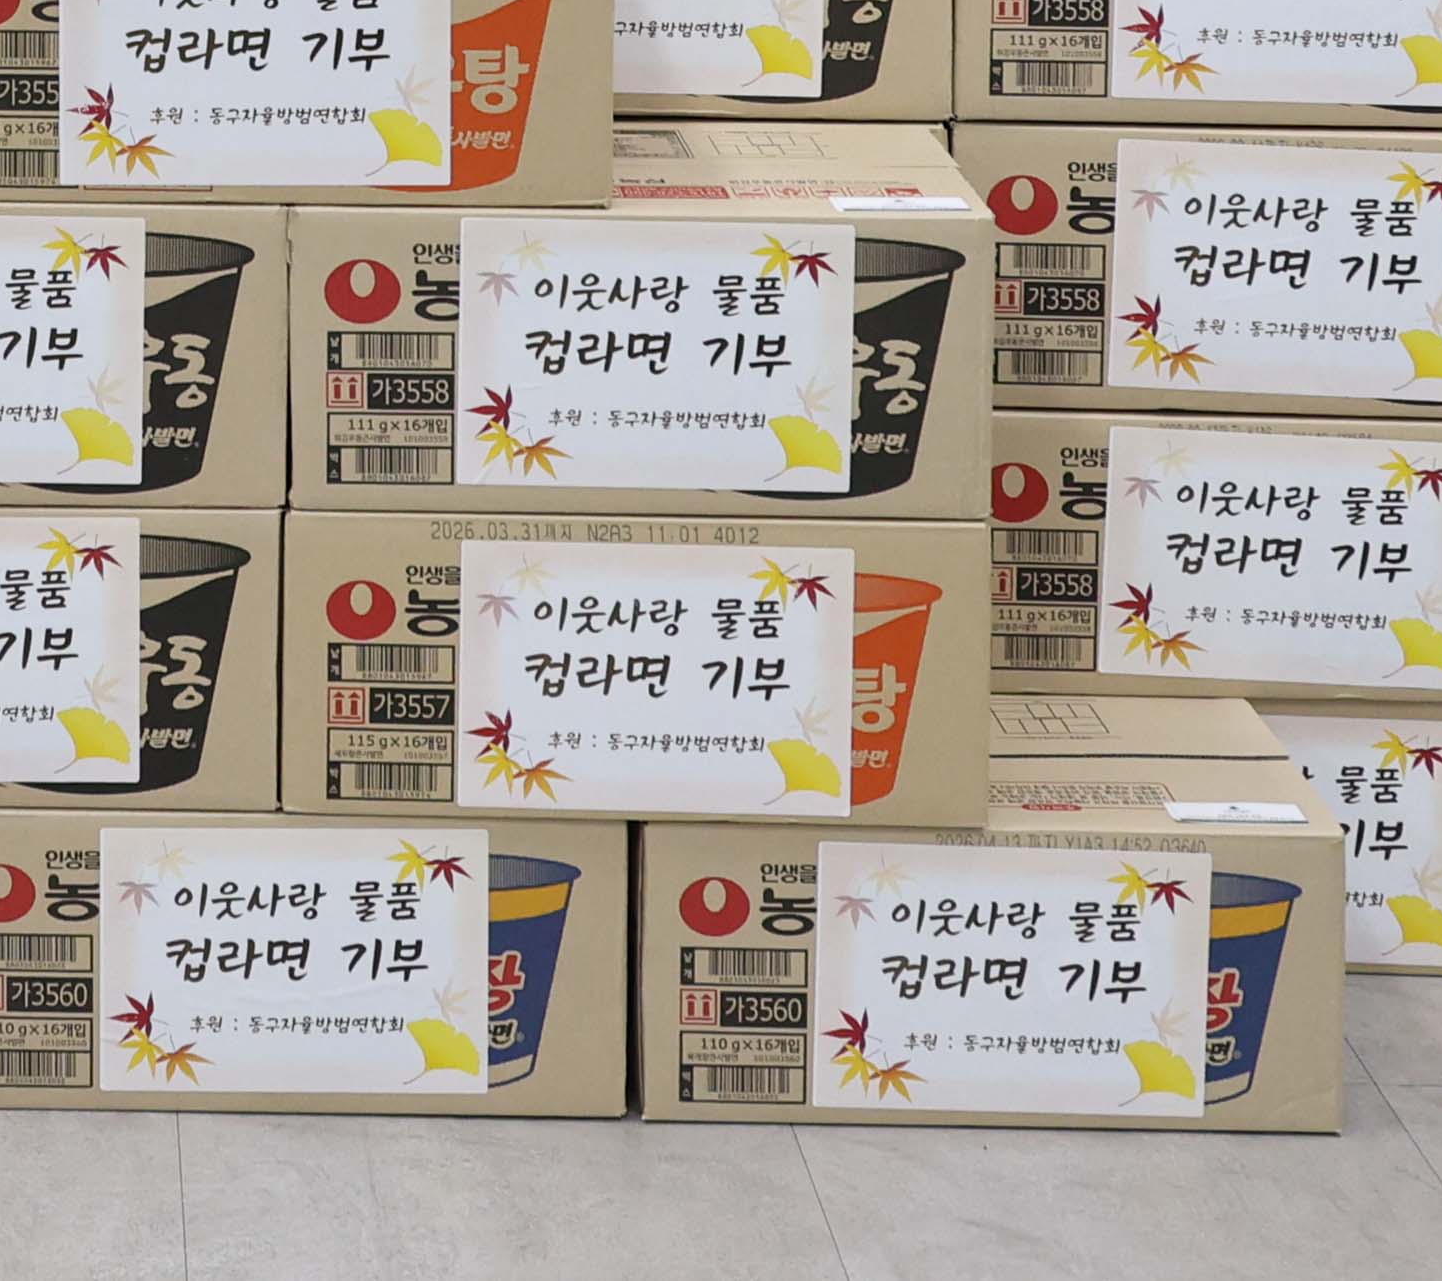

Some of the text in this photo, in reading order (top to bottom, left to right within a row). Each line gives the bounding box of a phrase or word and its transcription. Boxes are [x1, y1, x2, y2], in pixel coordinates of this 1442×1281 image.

[125, 27, 391, 74] 컵라면 기부
[614, 21, 744, 40] 구자율방범연합회
[1199, 28, 1228, 45] 후원
[1253, 29, 1399, 49] 동구자율방범연합회
[1184, 193, 1417, 237] 이웃사랑 물품
[5, 268, 76, 310] 물품
[1174, 245, 1422, 295] 컵라면 기부
[534, 273, 785, 317] 이웃사랑 물품
[1027, 286, 1101, 312] 가3558
[525, 330, 792, 378] 컵라면 기부
[372, 377, 450, 406] 가3558
[1176, 481, 1408, 526] 이웃사랑 물품
[587, 524, 632, 541] N2A3
[714, 527, 759, 544] 4012
[1166, 533, 1412, 583] 컵라면 기부
[0, 569, 71, 611] 물품
[534, 596, 783, 640] 이웃사랑 물품
[525, 652, 790, 701] 컵라면 기부
[373, 691, 451, 720] 가3557
[1335, 765, 1403, 804] 물품
[174, 881, 420, 922] 이웃사랑 물품
[891, 898, 1141, 943] 이웃사랑 물품
[166, 938, 428, 983] 컵라면 기부
[882, 954, 1147, 1004] 컵라면 기부
[11, 981, 88, 1008] 가3560
[725, 995, 802, 1023] 가3560
[190, 1015, 223, 1033] 후원
[249, 1016, 404, 1035] 동구자율방범연합회
